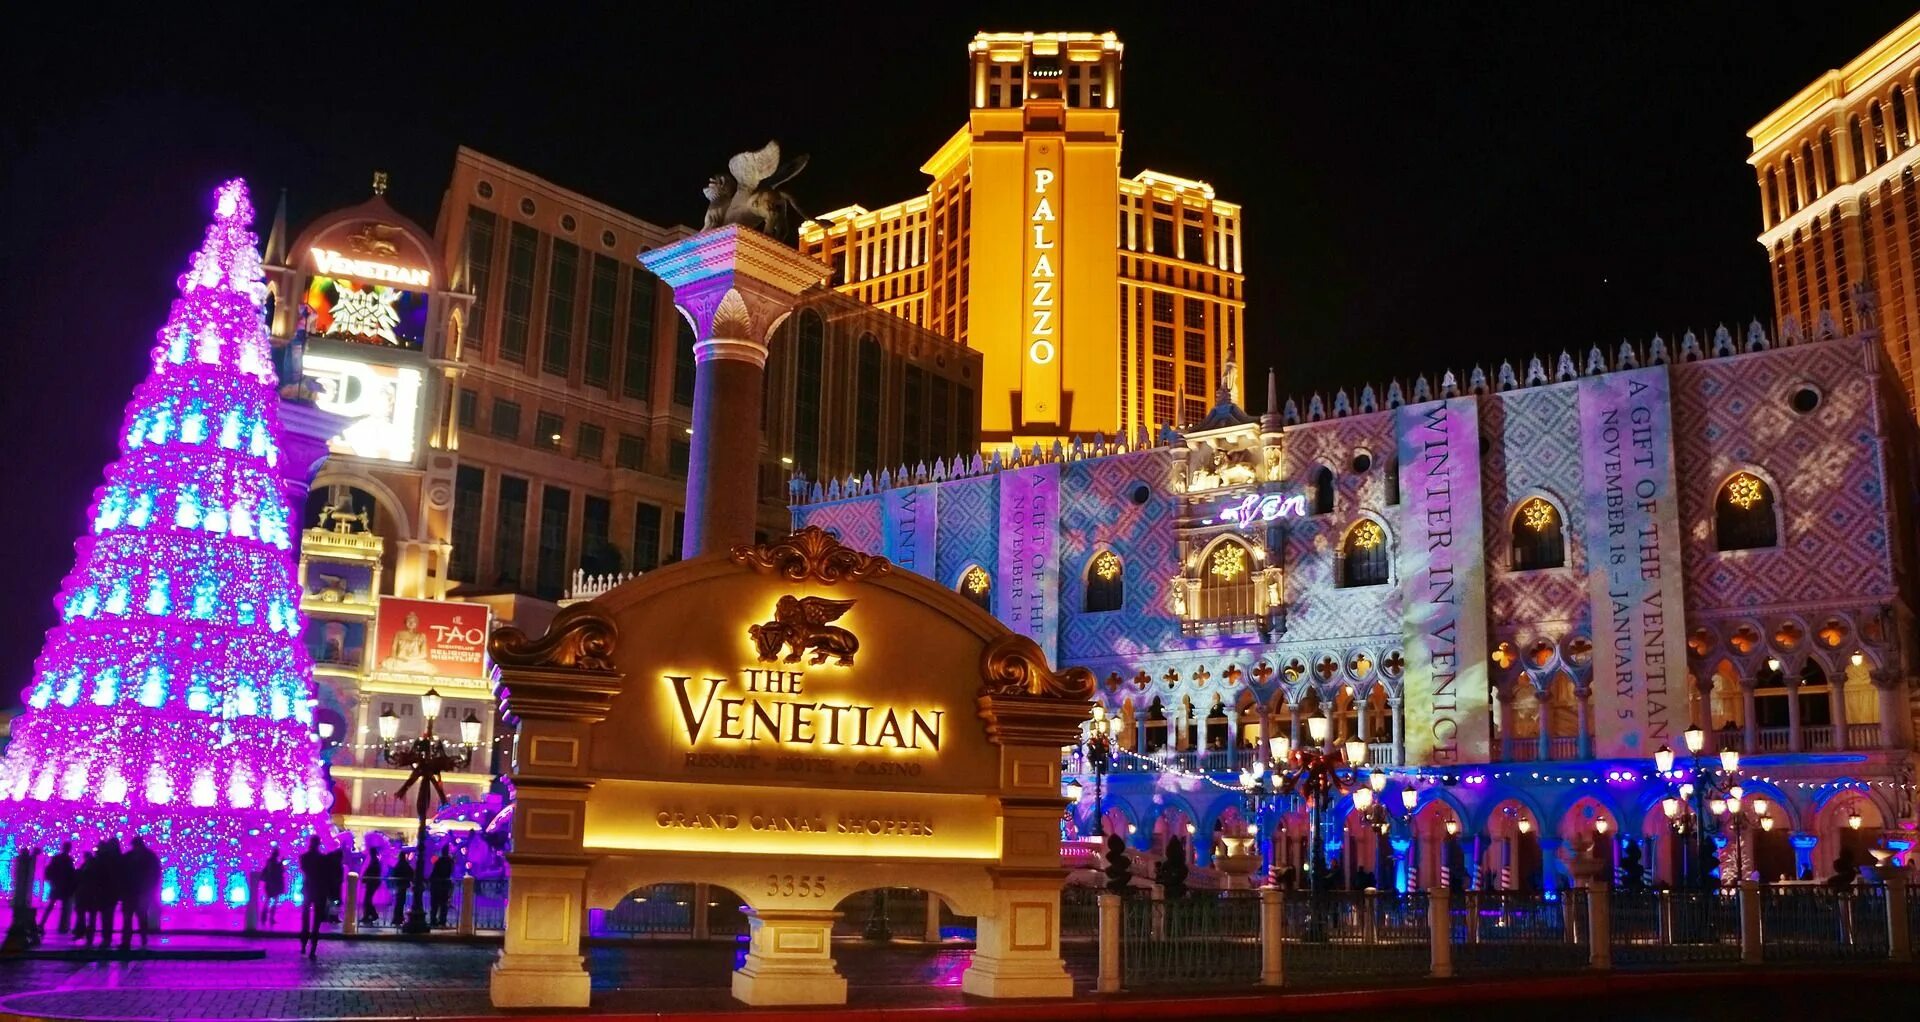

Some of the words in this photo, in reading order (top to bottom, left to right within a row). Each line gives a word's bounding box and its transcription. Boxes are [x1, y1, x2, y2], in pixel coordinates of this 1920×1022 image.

[310, 247, 431, 287] VENETIAN
[1030, 168, 1055, 364] PALAZZO
[1629, 379, 1648, 398] A
[1630, 407, 1654, 469] GIFT
[1032, 474, 1046, 488] A
[1424, 400, 1453, 553] WINTER
[1601, 408, 1625, 538] NOVEMBER
[1635, 479, 1657, 513] OF
[1032, 495, 1045, 546] GIFT
[1011, 497, 1025, 599] NOVEMBER
[1031, 554, 1044, 582] OF
[1610, 544, 1626, 566] 18
[1638, 523, 1661, 581] THE
[1429, 563, 1454, 605] IN
[1011, 606, 1022, 622] 18
[1030, 591, 1043, 635] THE
[430, 625, 484, 645] TAO
[1609, 590, 1633, 699] JANUARY
[743, 668, 803, 694] THE
[1642, 589, 1669, 740] VENETIAN
[1430, 618, 1457, 764] VENICE
[664, 675, 945, 751] VENETIAN
[1617, 709, 1633, 720] 5
[684, 752, 761, 770] RESORT
[776, 755, 836, 774] HOTEL
[854, 760, 923, 778] CASINO
[655, 811, 739, 831] GRAND
[750, 815, 828, 833] CANAL
[837, 819, 934, 837] SHOPPES
[766, 874, 827, 898] 3355
